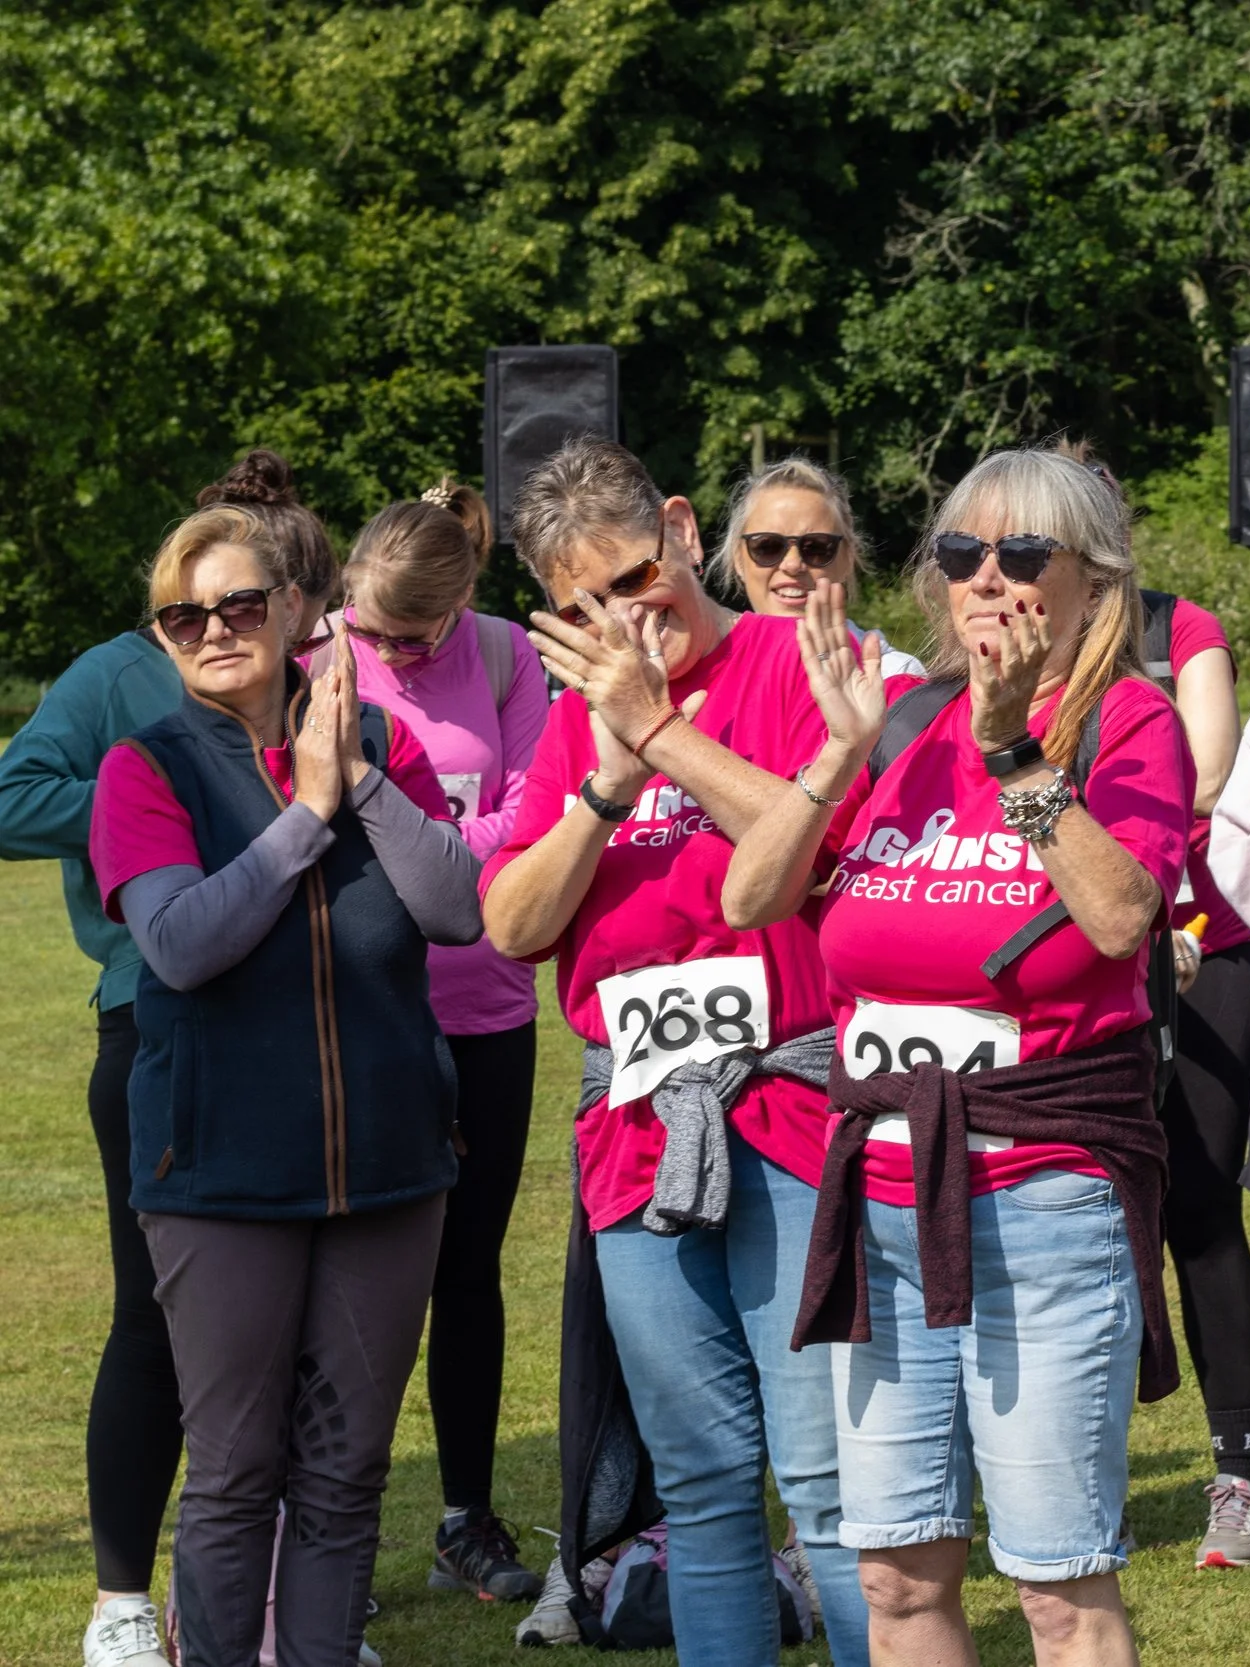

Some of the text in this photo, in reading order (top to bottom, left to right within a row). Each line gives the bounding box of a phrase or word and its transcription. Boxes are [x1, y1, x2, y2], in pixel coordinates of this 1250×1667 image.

[630, 813, 721, 848] cance
[925, 874, 1042, 906] cancer
[618, 985, 756, 1073] 268
